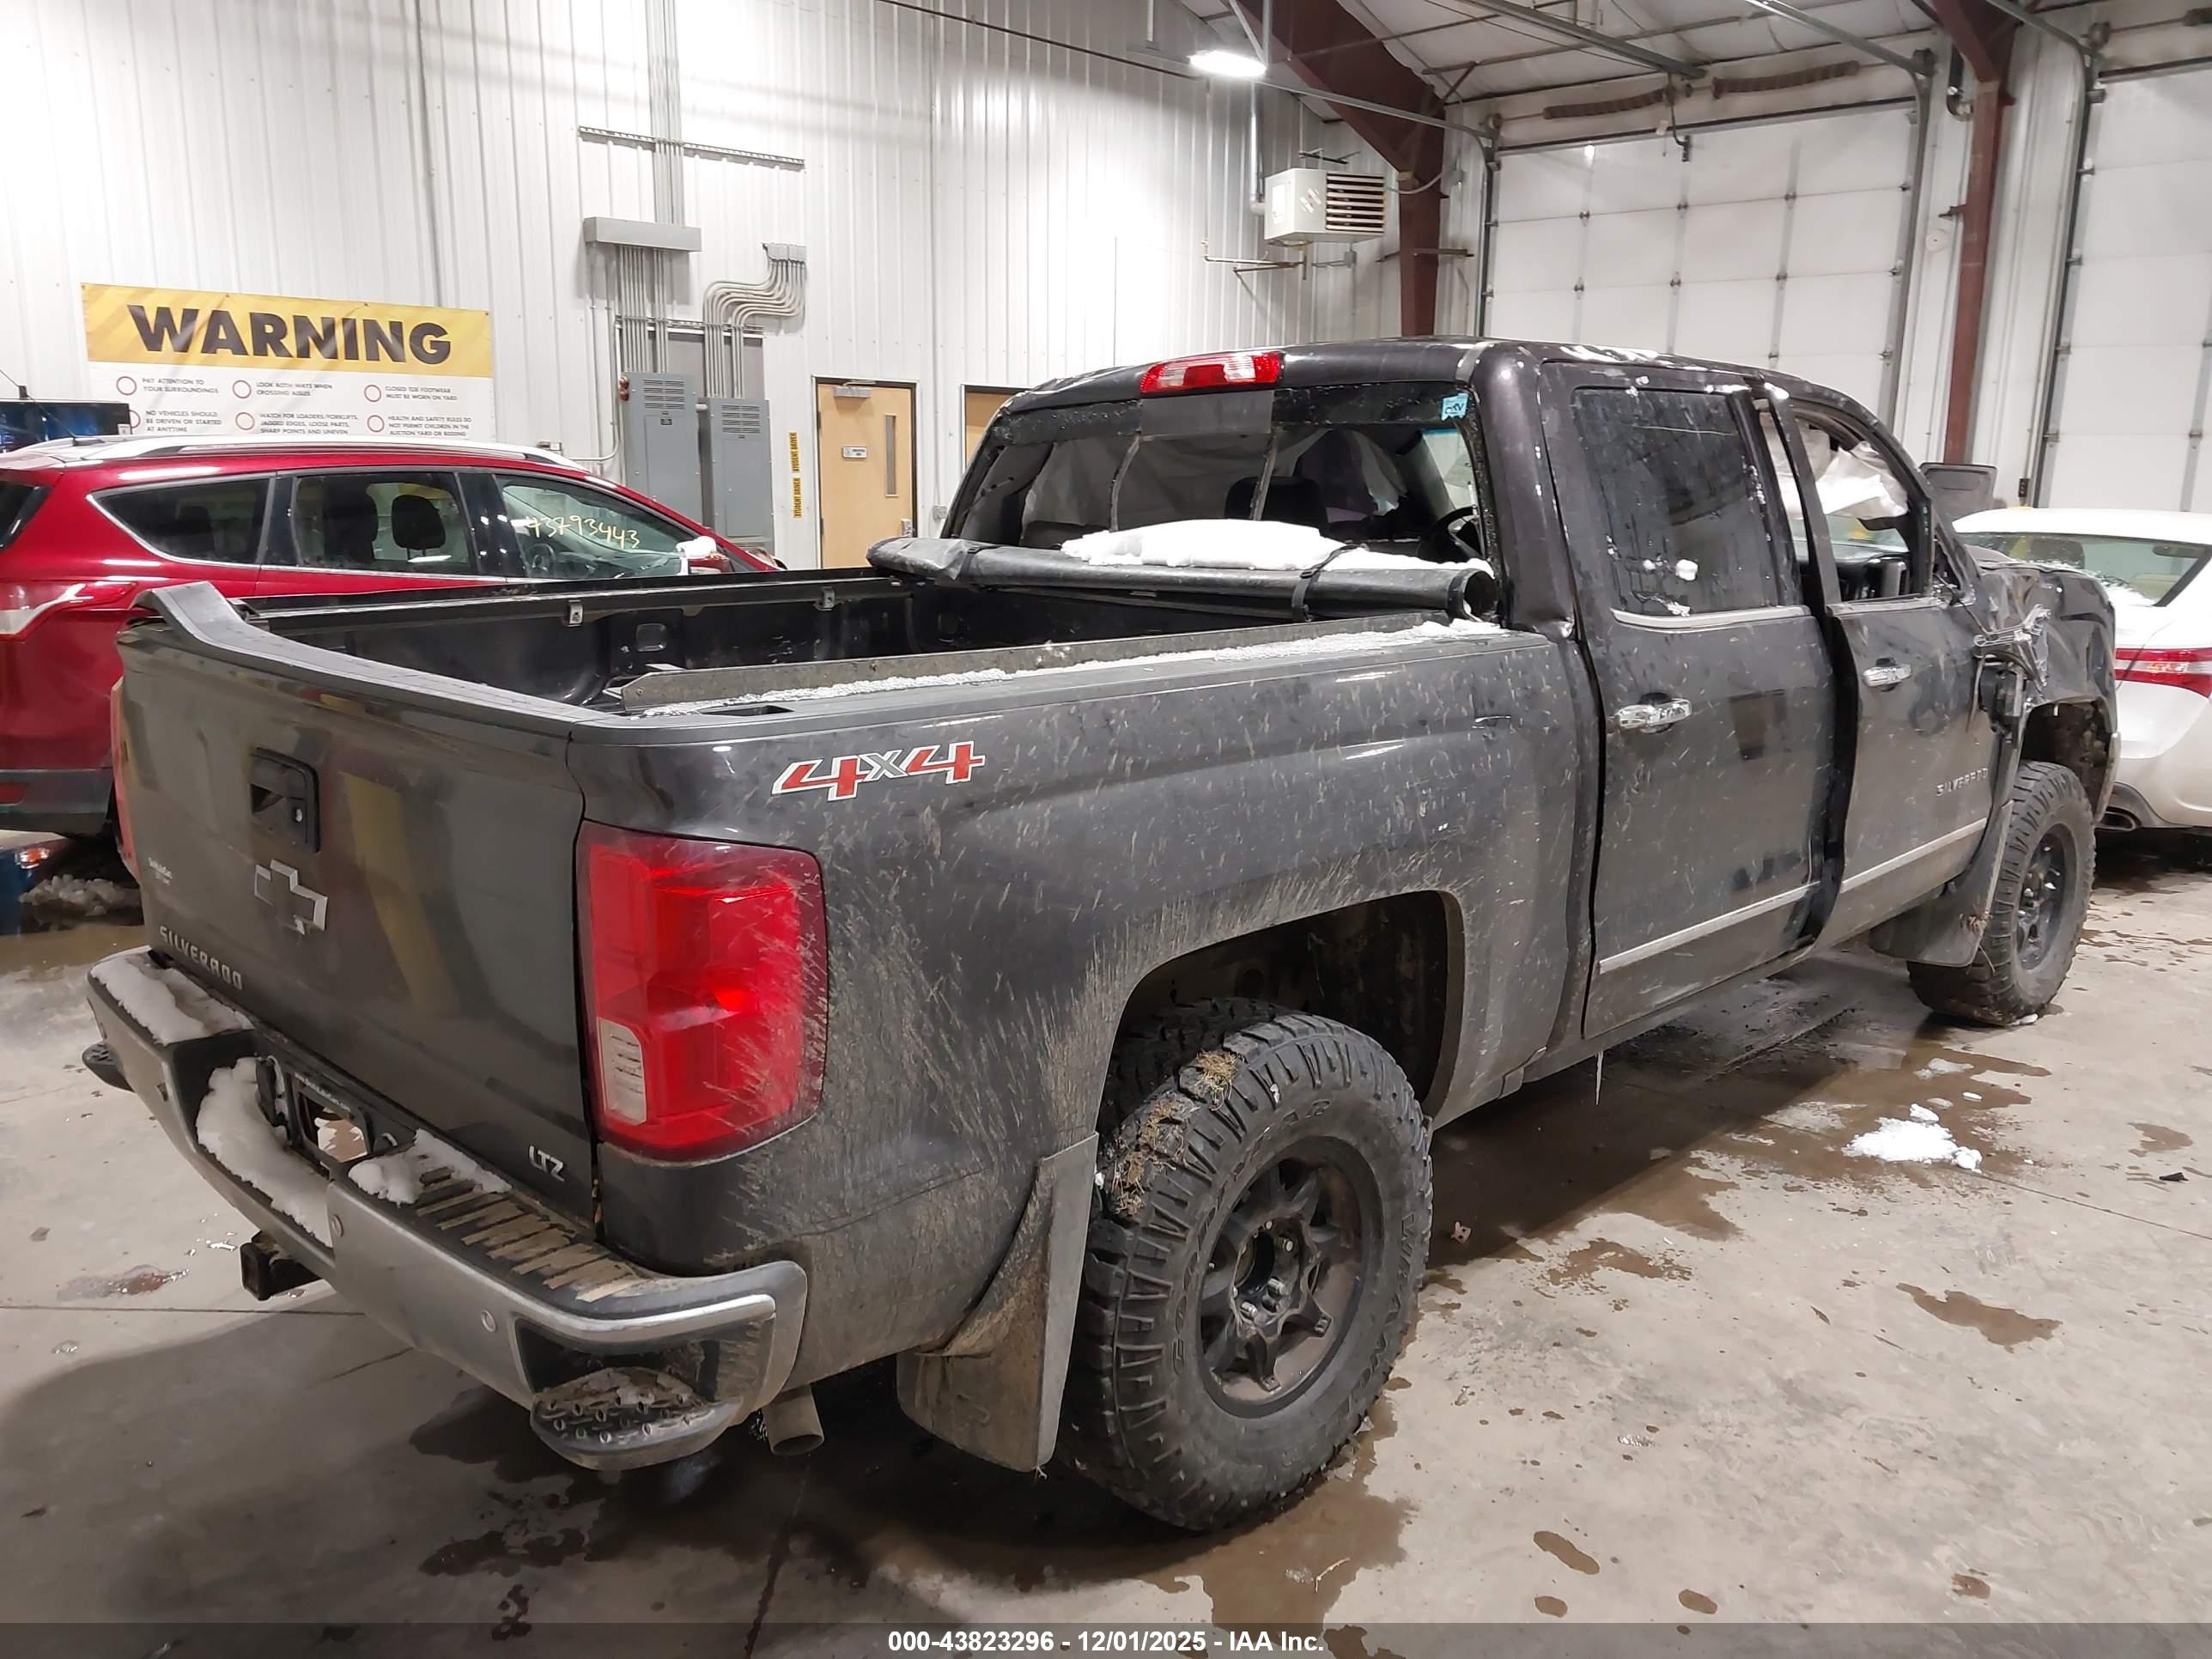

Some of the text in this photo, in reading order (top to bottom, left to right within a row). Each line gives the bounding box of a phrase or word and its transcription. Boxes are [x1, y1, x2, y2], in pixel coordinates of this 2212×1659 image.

[127, 305, 451, 365] WARNING
[160, 926, 243, 990] SILVERADO
[528, 1145, 566, 1182] LTZ
